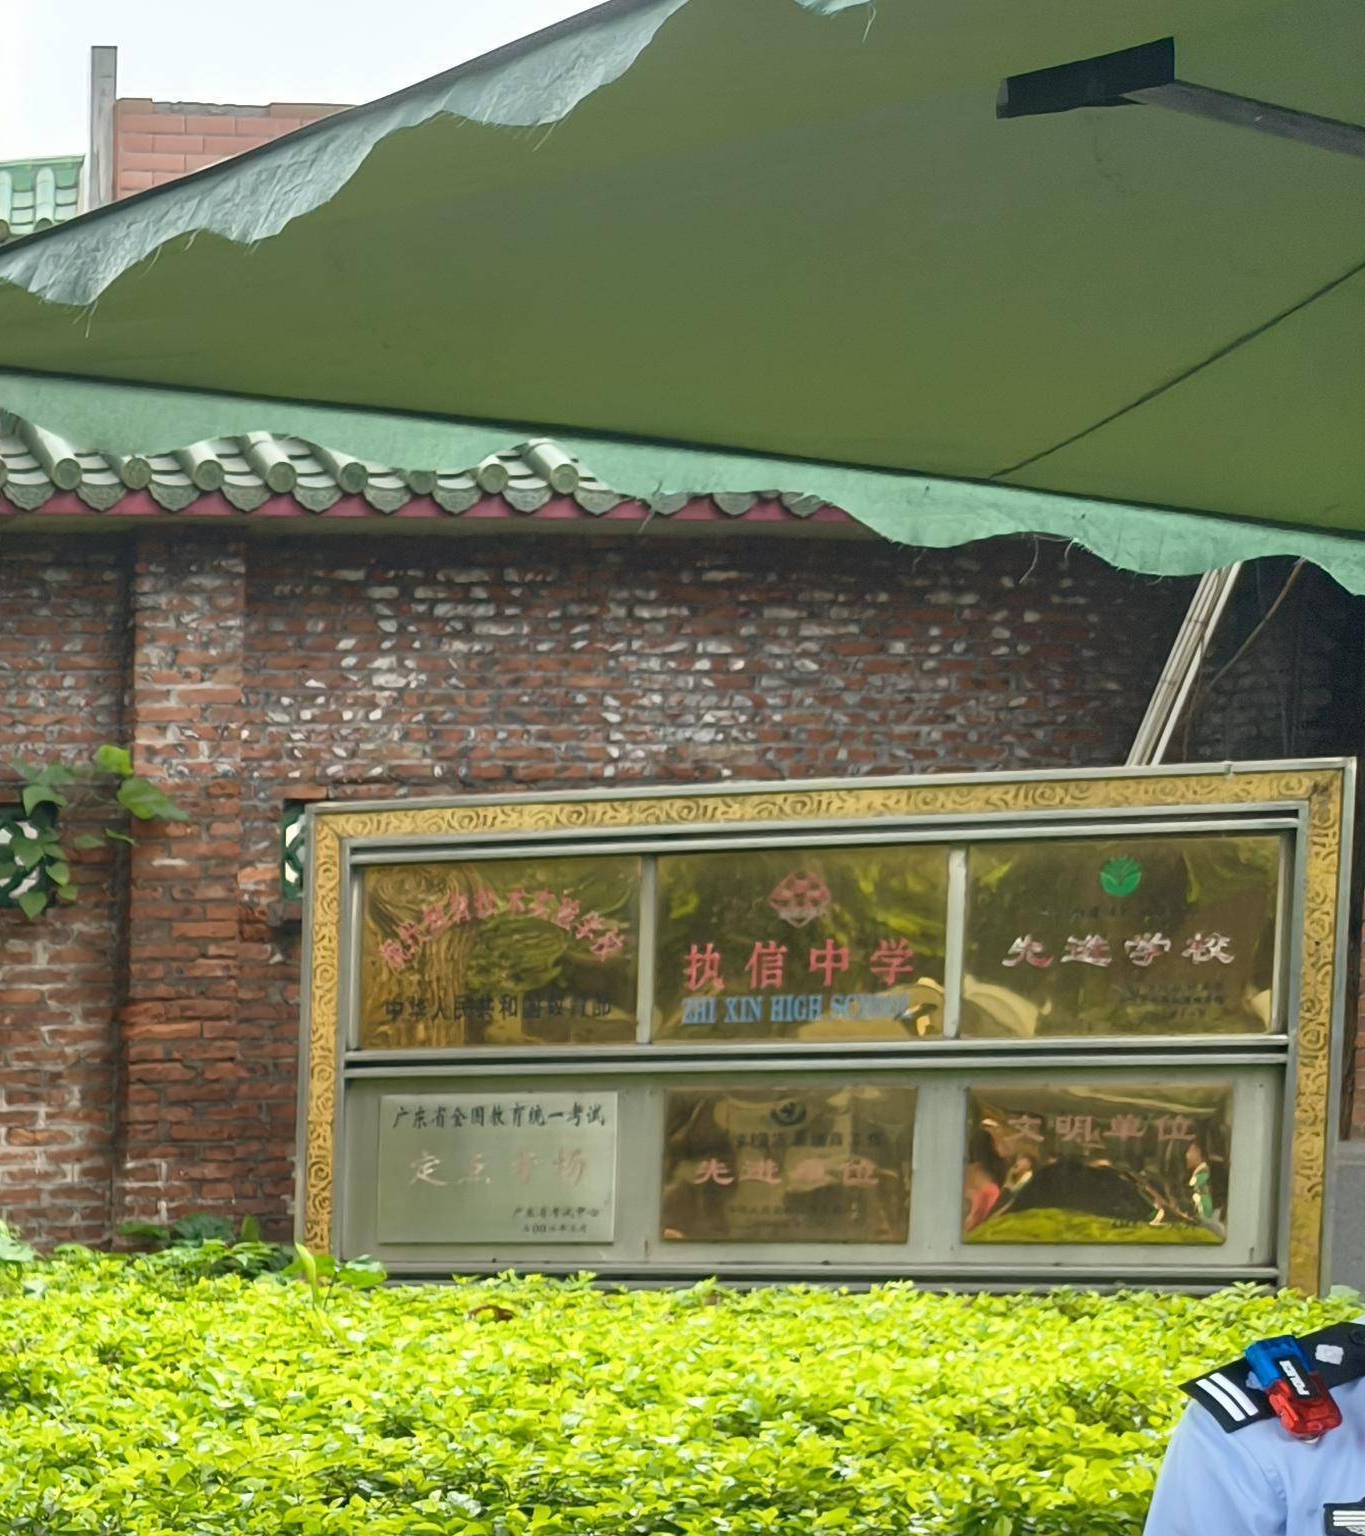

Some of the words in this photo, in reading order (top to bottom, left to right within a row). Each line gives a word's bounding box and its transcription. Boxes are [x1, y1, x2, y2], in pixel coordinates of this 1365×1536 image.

[1002, 931, 1236, 968] 先进学校
[682, 938, 915, 993] 执信中学
[681, 996, 717, 1025] ZHI
[723, 995, 763, 1024] XIN
[770, 994, 823, 1022] HIGH
[392, 1102, 607, 1129] 广东省全国教育统一考试
[1007, 1114, 1197, 1143] 文明单位
